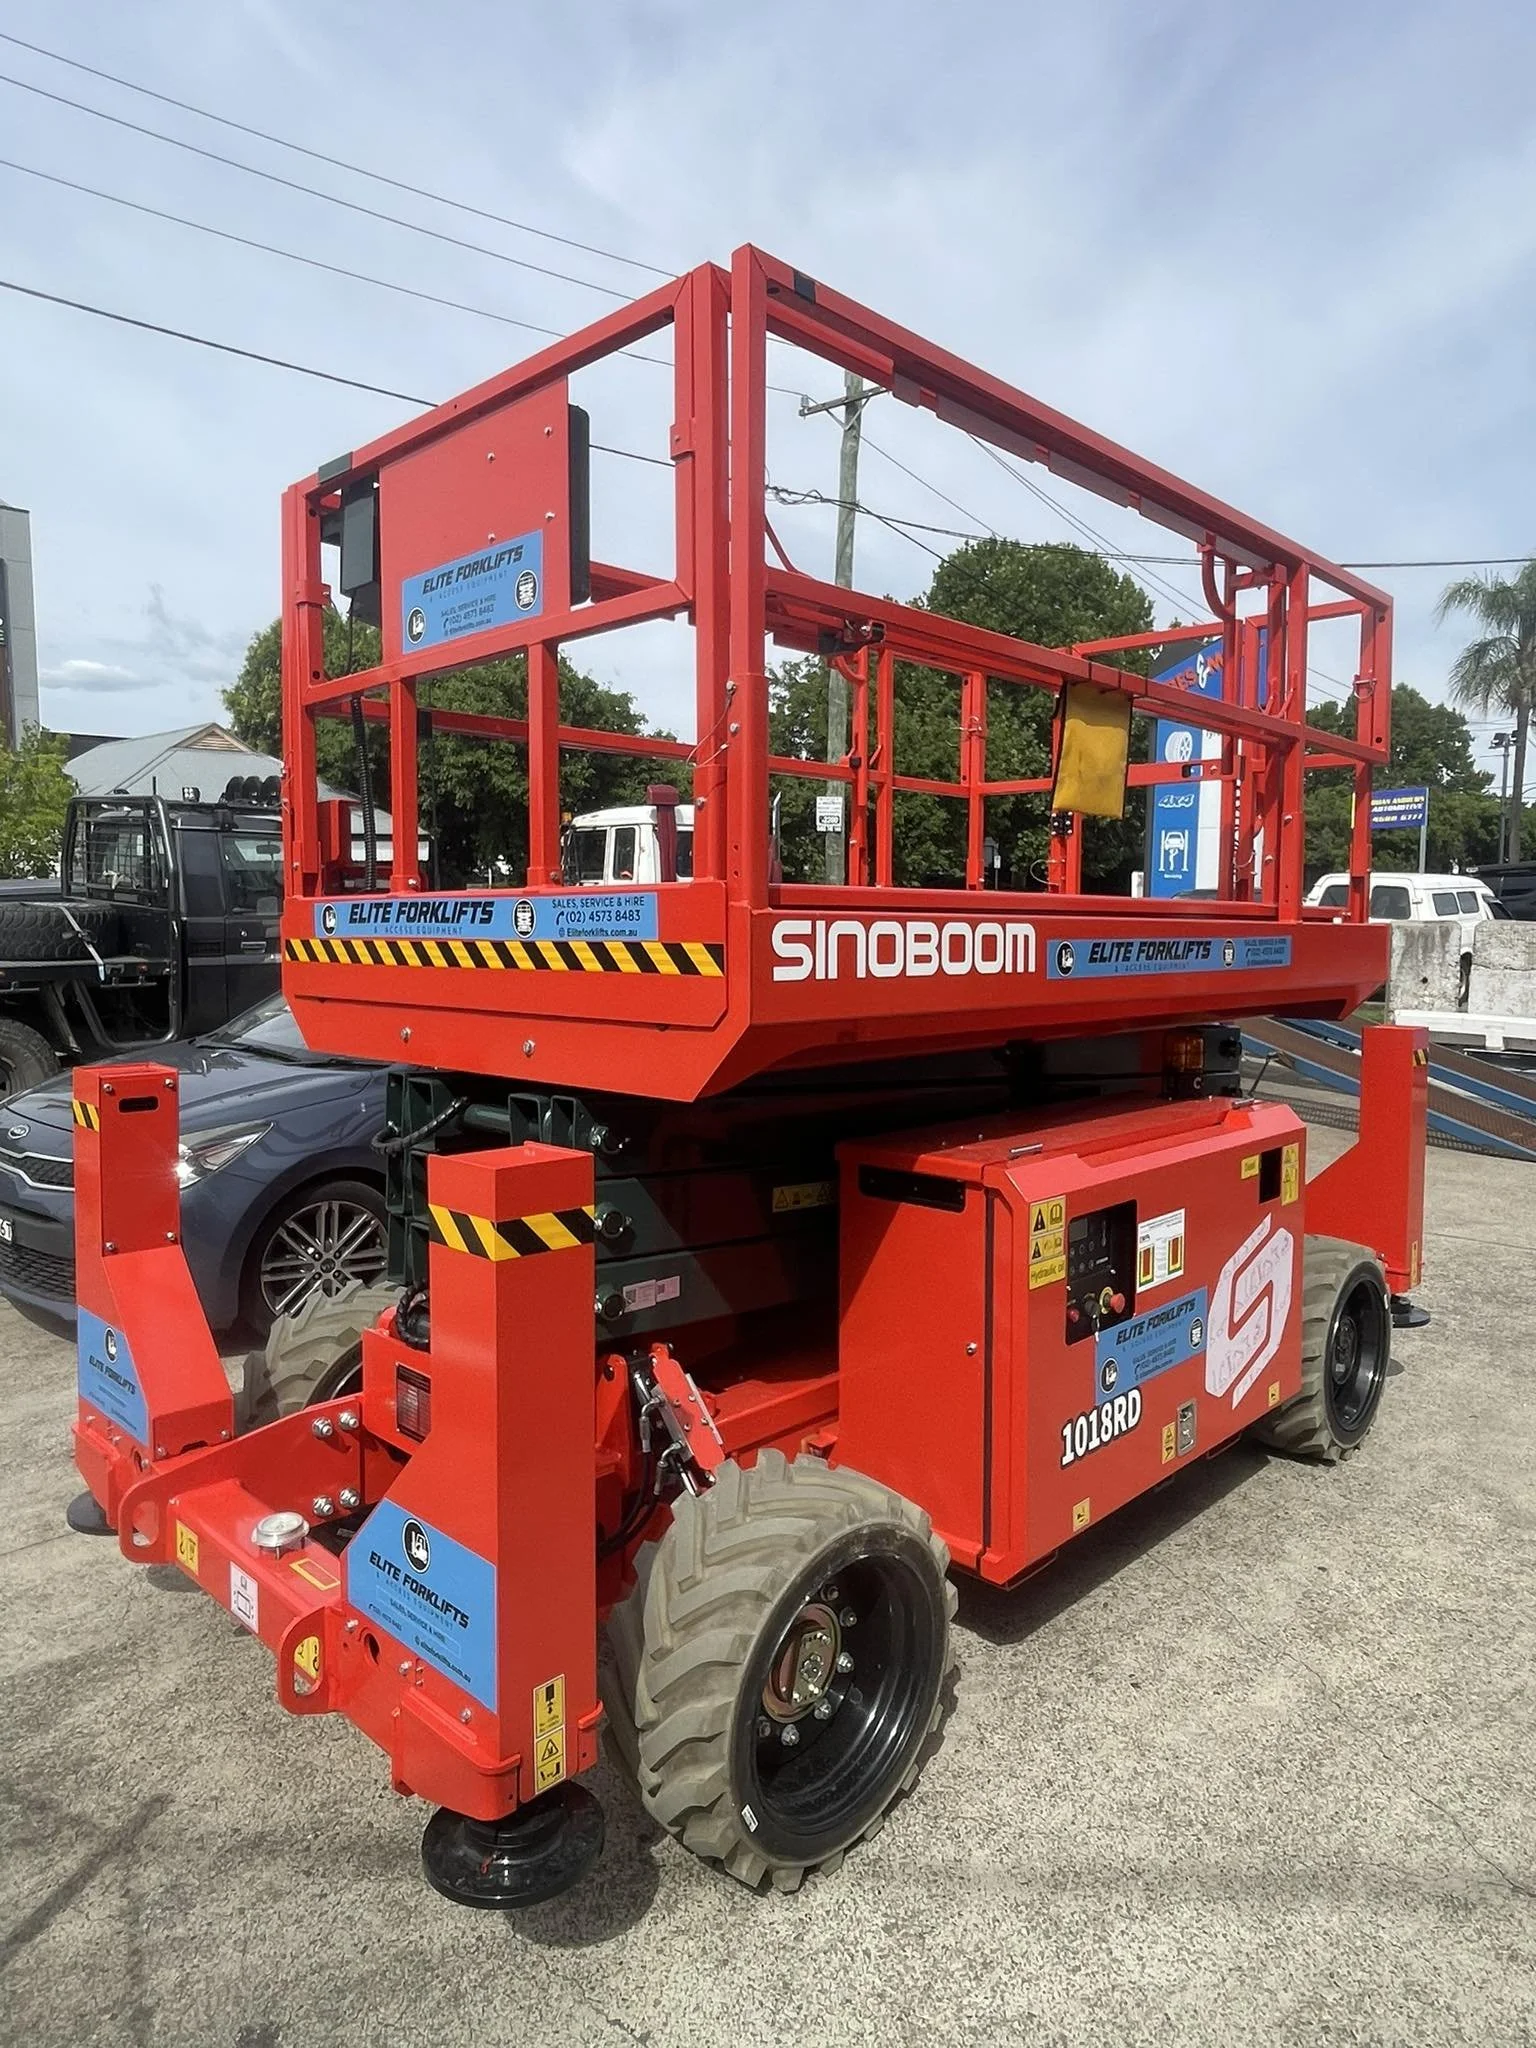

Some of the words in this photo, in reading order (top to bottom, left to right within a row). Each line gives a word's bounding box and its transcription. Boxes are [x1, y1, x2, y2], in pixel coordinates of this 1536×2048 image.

[422, 570, 454, 595] ELITE
[455, 544, 524, 583] FORKLIFTS
[348, 901, 393, 924] ELITE
[395, 900, 496, 924] FORKLIFTS
[552, 898, 579, 910] SALES,
[581, 897, 614, 908] SERVICE
[616, 897, 622, 907] &
[624, 896, 645, 907] HIRE
[565, 911, 586, 924] (02)
[588, 910, 612, 923] 4573
[615, 909, 641, 922] 8483
[385, 925, 414, 934] ACCESS
[416, 926, 463, 936] EQUIPMENT
[567, 927, 638, 938] Eliteforklifts.com.au
[771, 919, 1036, 982] SINOBOOM
[1088, 941, 1135, 965] ELITE
[1136, 940, 1212, 963] FORKLIFTS
[1115, 1321, 1146, 1346] ELITE
[1146, 1297, 1197, 1332] FORKLIFTS
[88, 1354, 104, 1372] ELITE
[104, 1365, 137, 1395] FORKLIFTS
[1061, 1387, 1142, 1467] 1018RD
[369, 1550, 402, 1582] ELITE
[402, 1572, 470, 1629] FORKLIFTS
